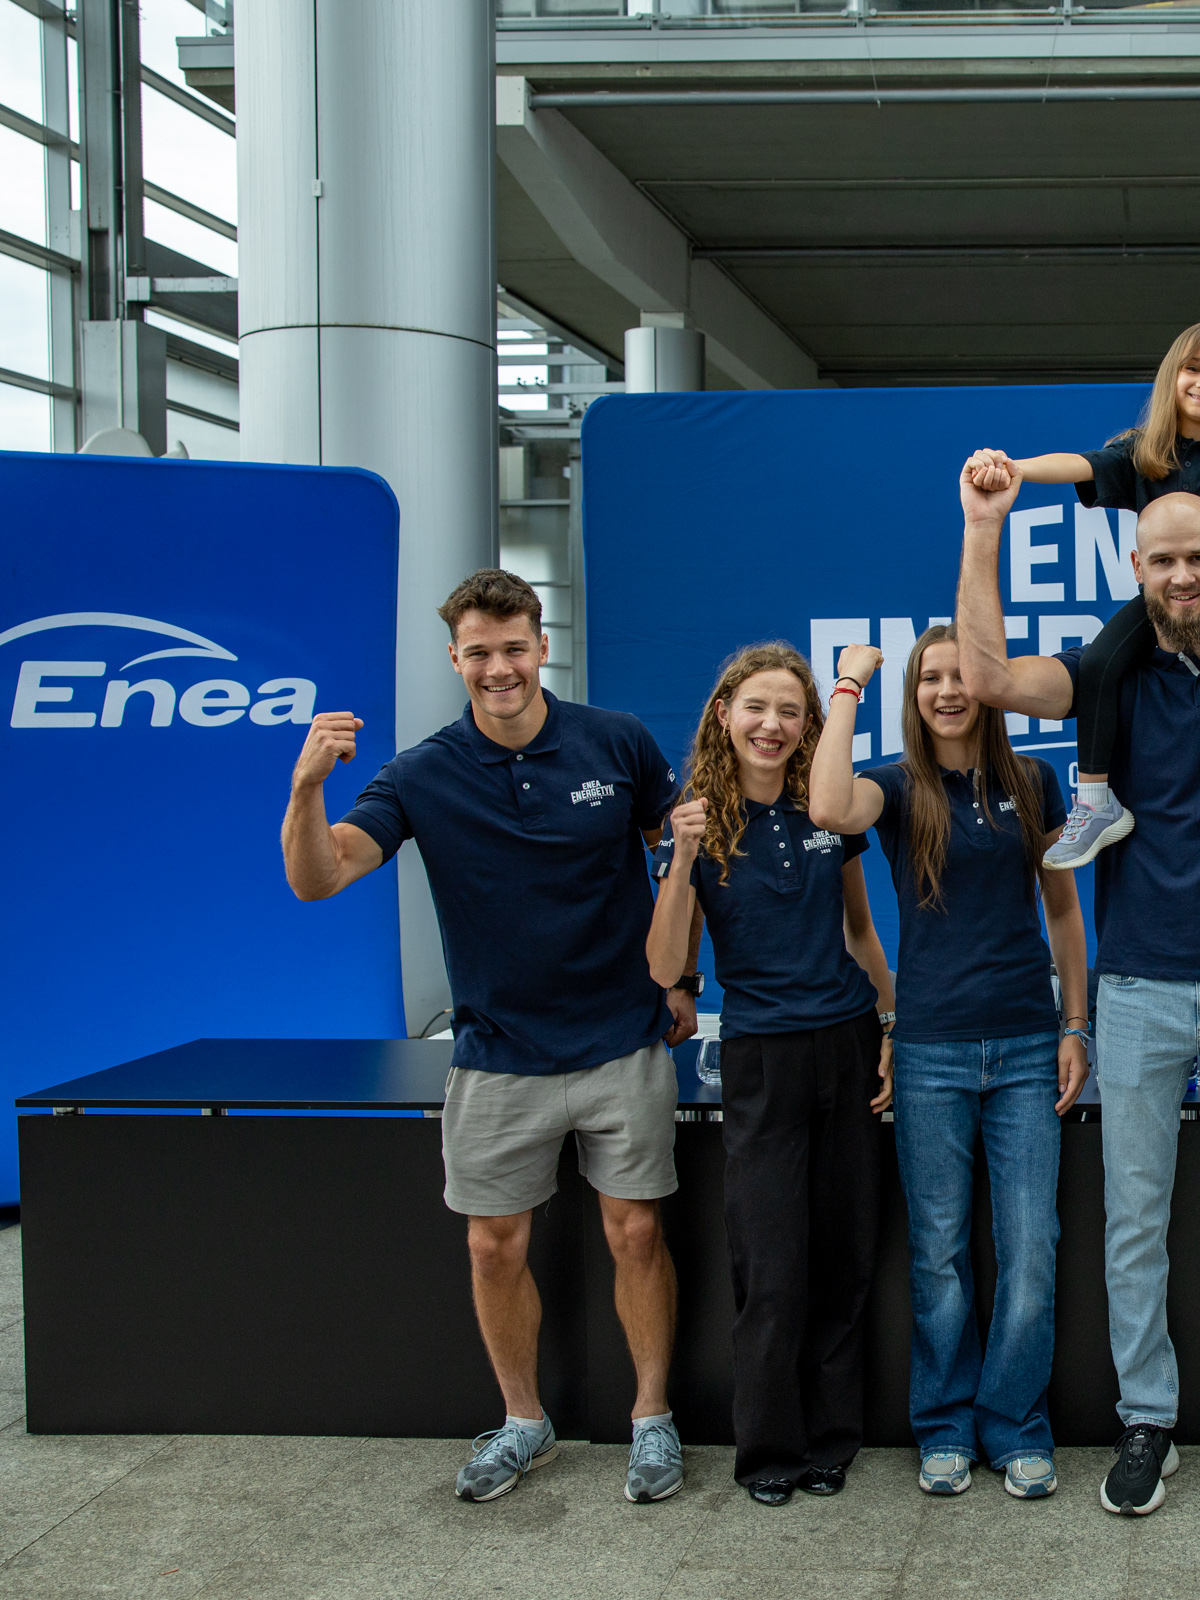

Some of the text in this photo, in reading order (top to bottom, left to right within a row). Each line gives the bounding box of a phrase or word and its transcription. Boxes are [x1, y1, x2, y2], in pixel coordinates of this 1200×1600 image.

[10, 660, 318, 728] Enea
[581, 779, 602, 791] ENEA
[570, 783, 615, 804] ENERGETYK
[812, 829, 830, 839] ENEA
